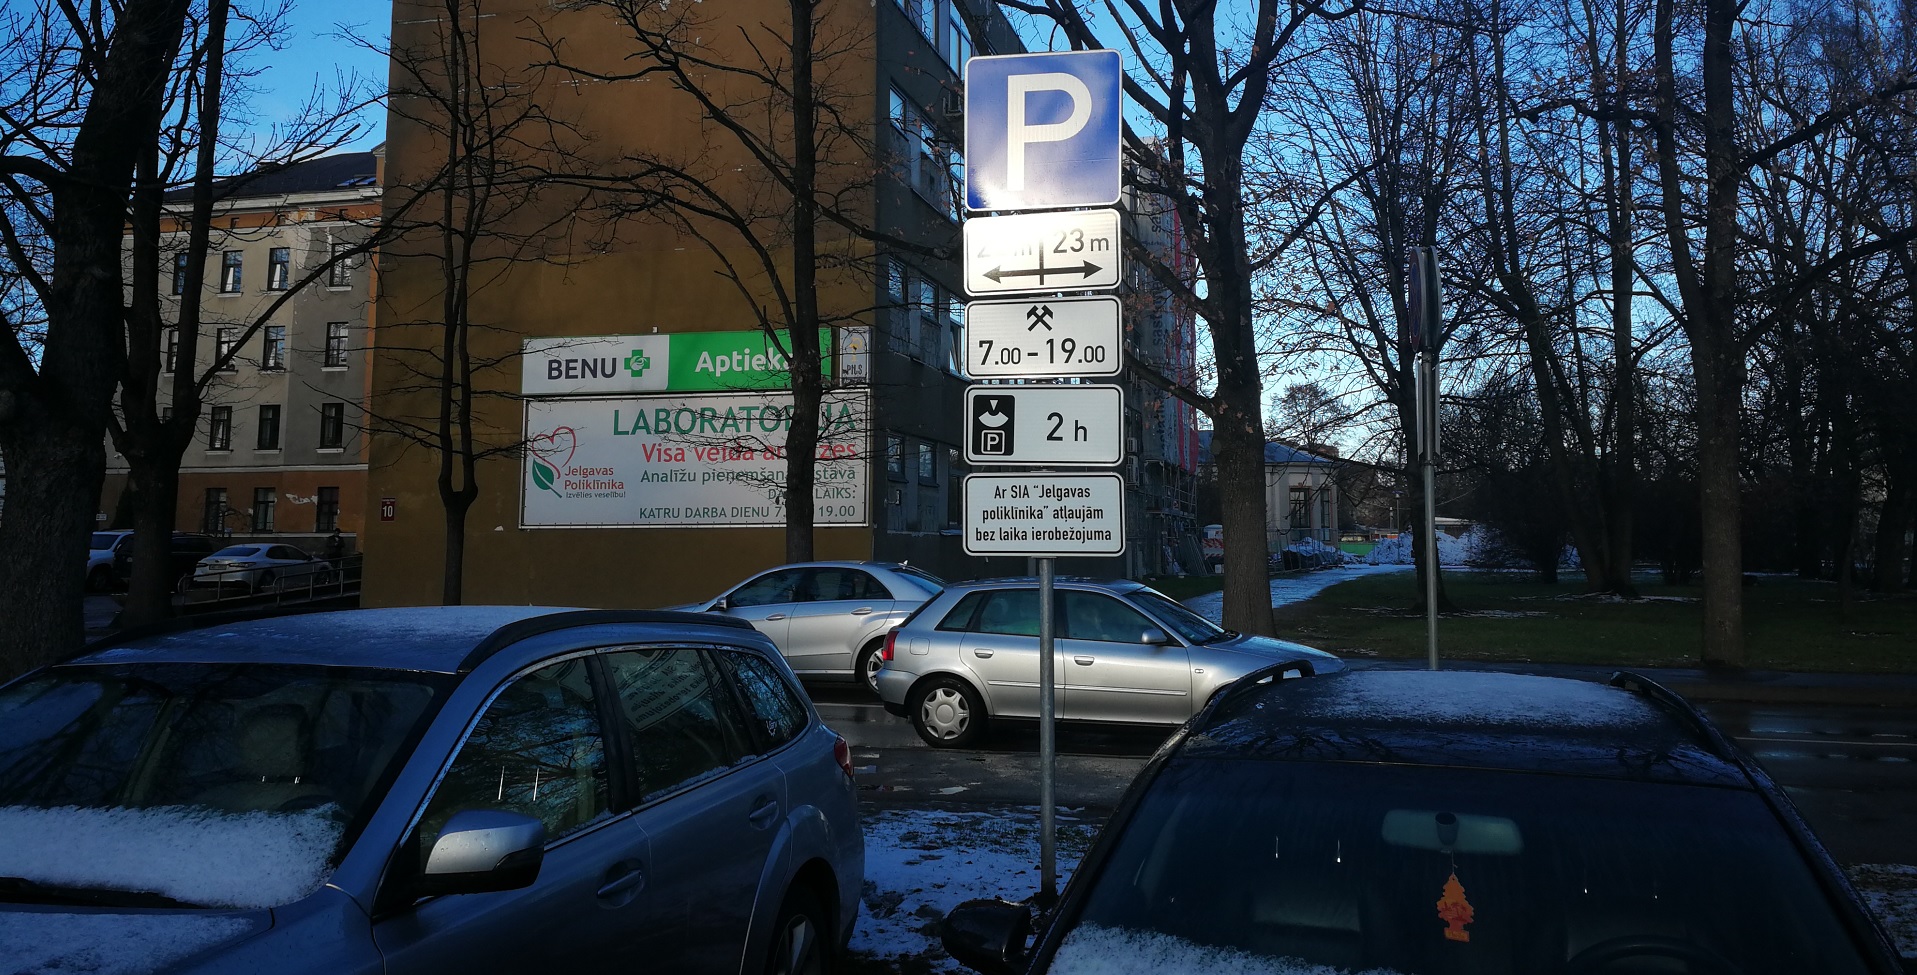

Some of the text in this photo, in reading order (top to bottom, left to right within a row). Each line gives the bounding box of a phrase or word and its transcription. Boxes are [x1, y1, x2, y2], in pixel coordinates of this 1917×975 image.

[1007, 72, 1092, 192] P
[1053, 228, 1109, 253] 23 m
[979, 340, 1021, 365] 7.00
[1046, 337, 1105, 364] 19.00
[547, 357, 617, 380] BENU
[847, 364, 862, 376] PILS
[613, 403, 856, 435] LABORATOJA
[1046, 412, 1088, 441] 2 h
[986, 434, 999, 450] P
[642, 443, 686, 462] Visa
[694, 441, 755, 461] veida
[565, 466, 614, 478] Jelgavas
[641, 467, 787, 485] Analīžu pieņemšan
[816, 466, 856, 480] stāvā
[564, 479, 624, 490] Poliklīnika
[994, 485, 1007, 499] Ar
[1010, 485, 1030, 499] SIA
[566, 491, 593, 499] Izvēlies
[816, 487, 856, 499] LAIKS:
[382, 505, 393, 517] 10
[640, 508, 680, 519] KATRU
[685, 507, 727, 518] DARBA
[731, 506, 770, 518] DIENU
[819, 505, 856, 517] 19.00
[1053, 505, 1104, 522] atļaujām
[975, 526, 1112, 544] bez laika ierobežojuma
